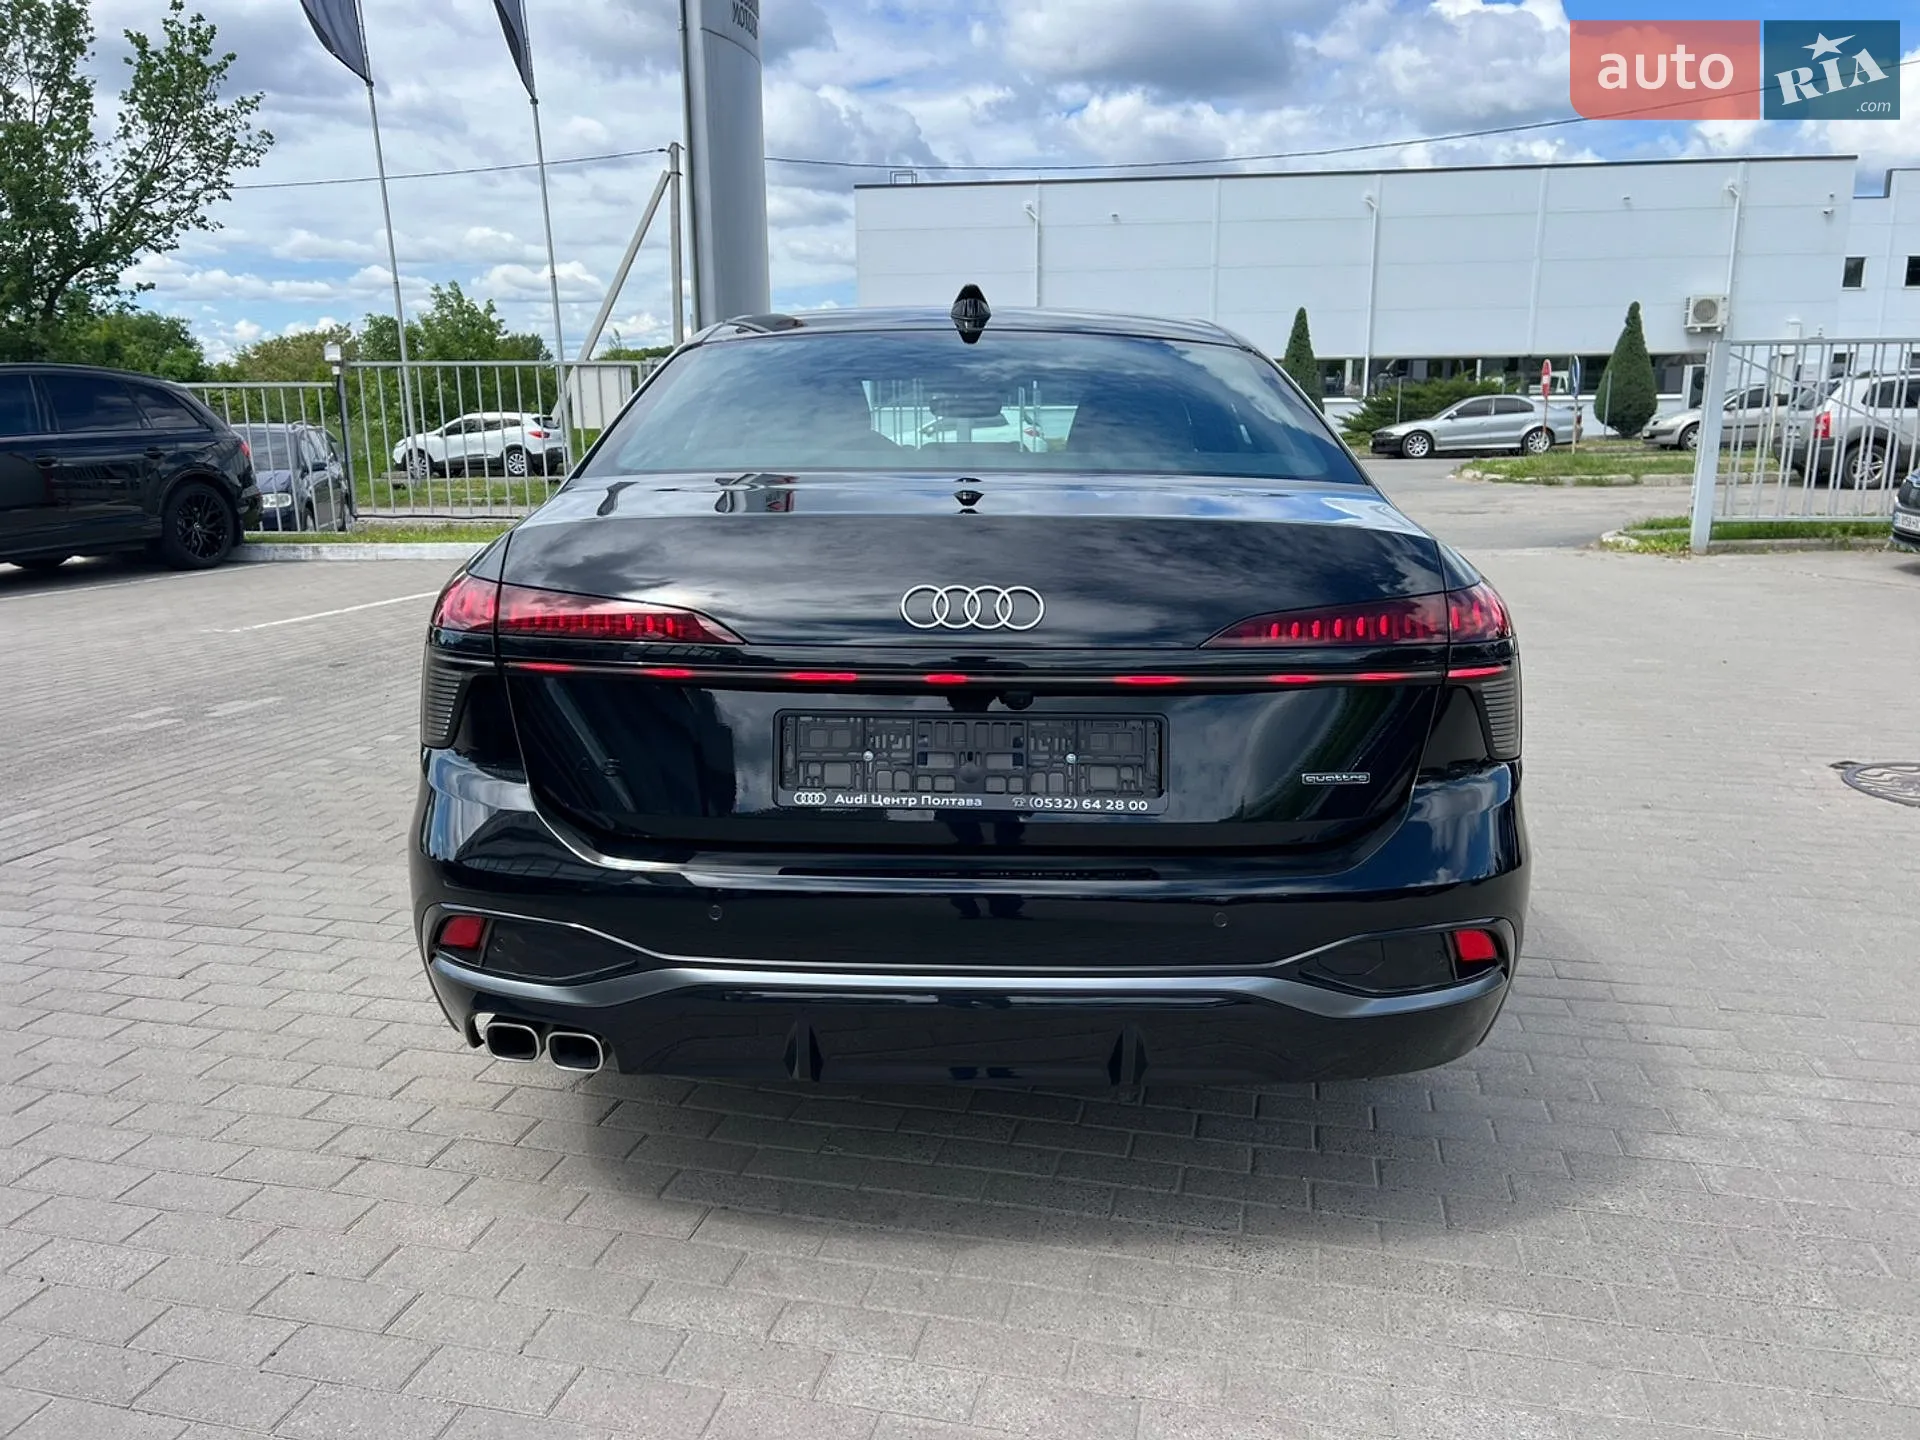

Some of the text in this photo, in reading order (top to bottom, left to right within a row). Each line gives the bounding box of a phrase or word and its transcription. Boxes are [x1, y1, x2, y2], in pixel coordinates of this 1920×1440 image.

[1305, 774, 1367, 784] quattro
[834, 794, 1148, 811] Audi Центр Полтава (0532) 64 28 00
